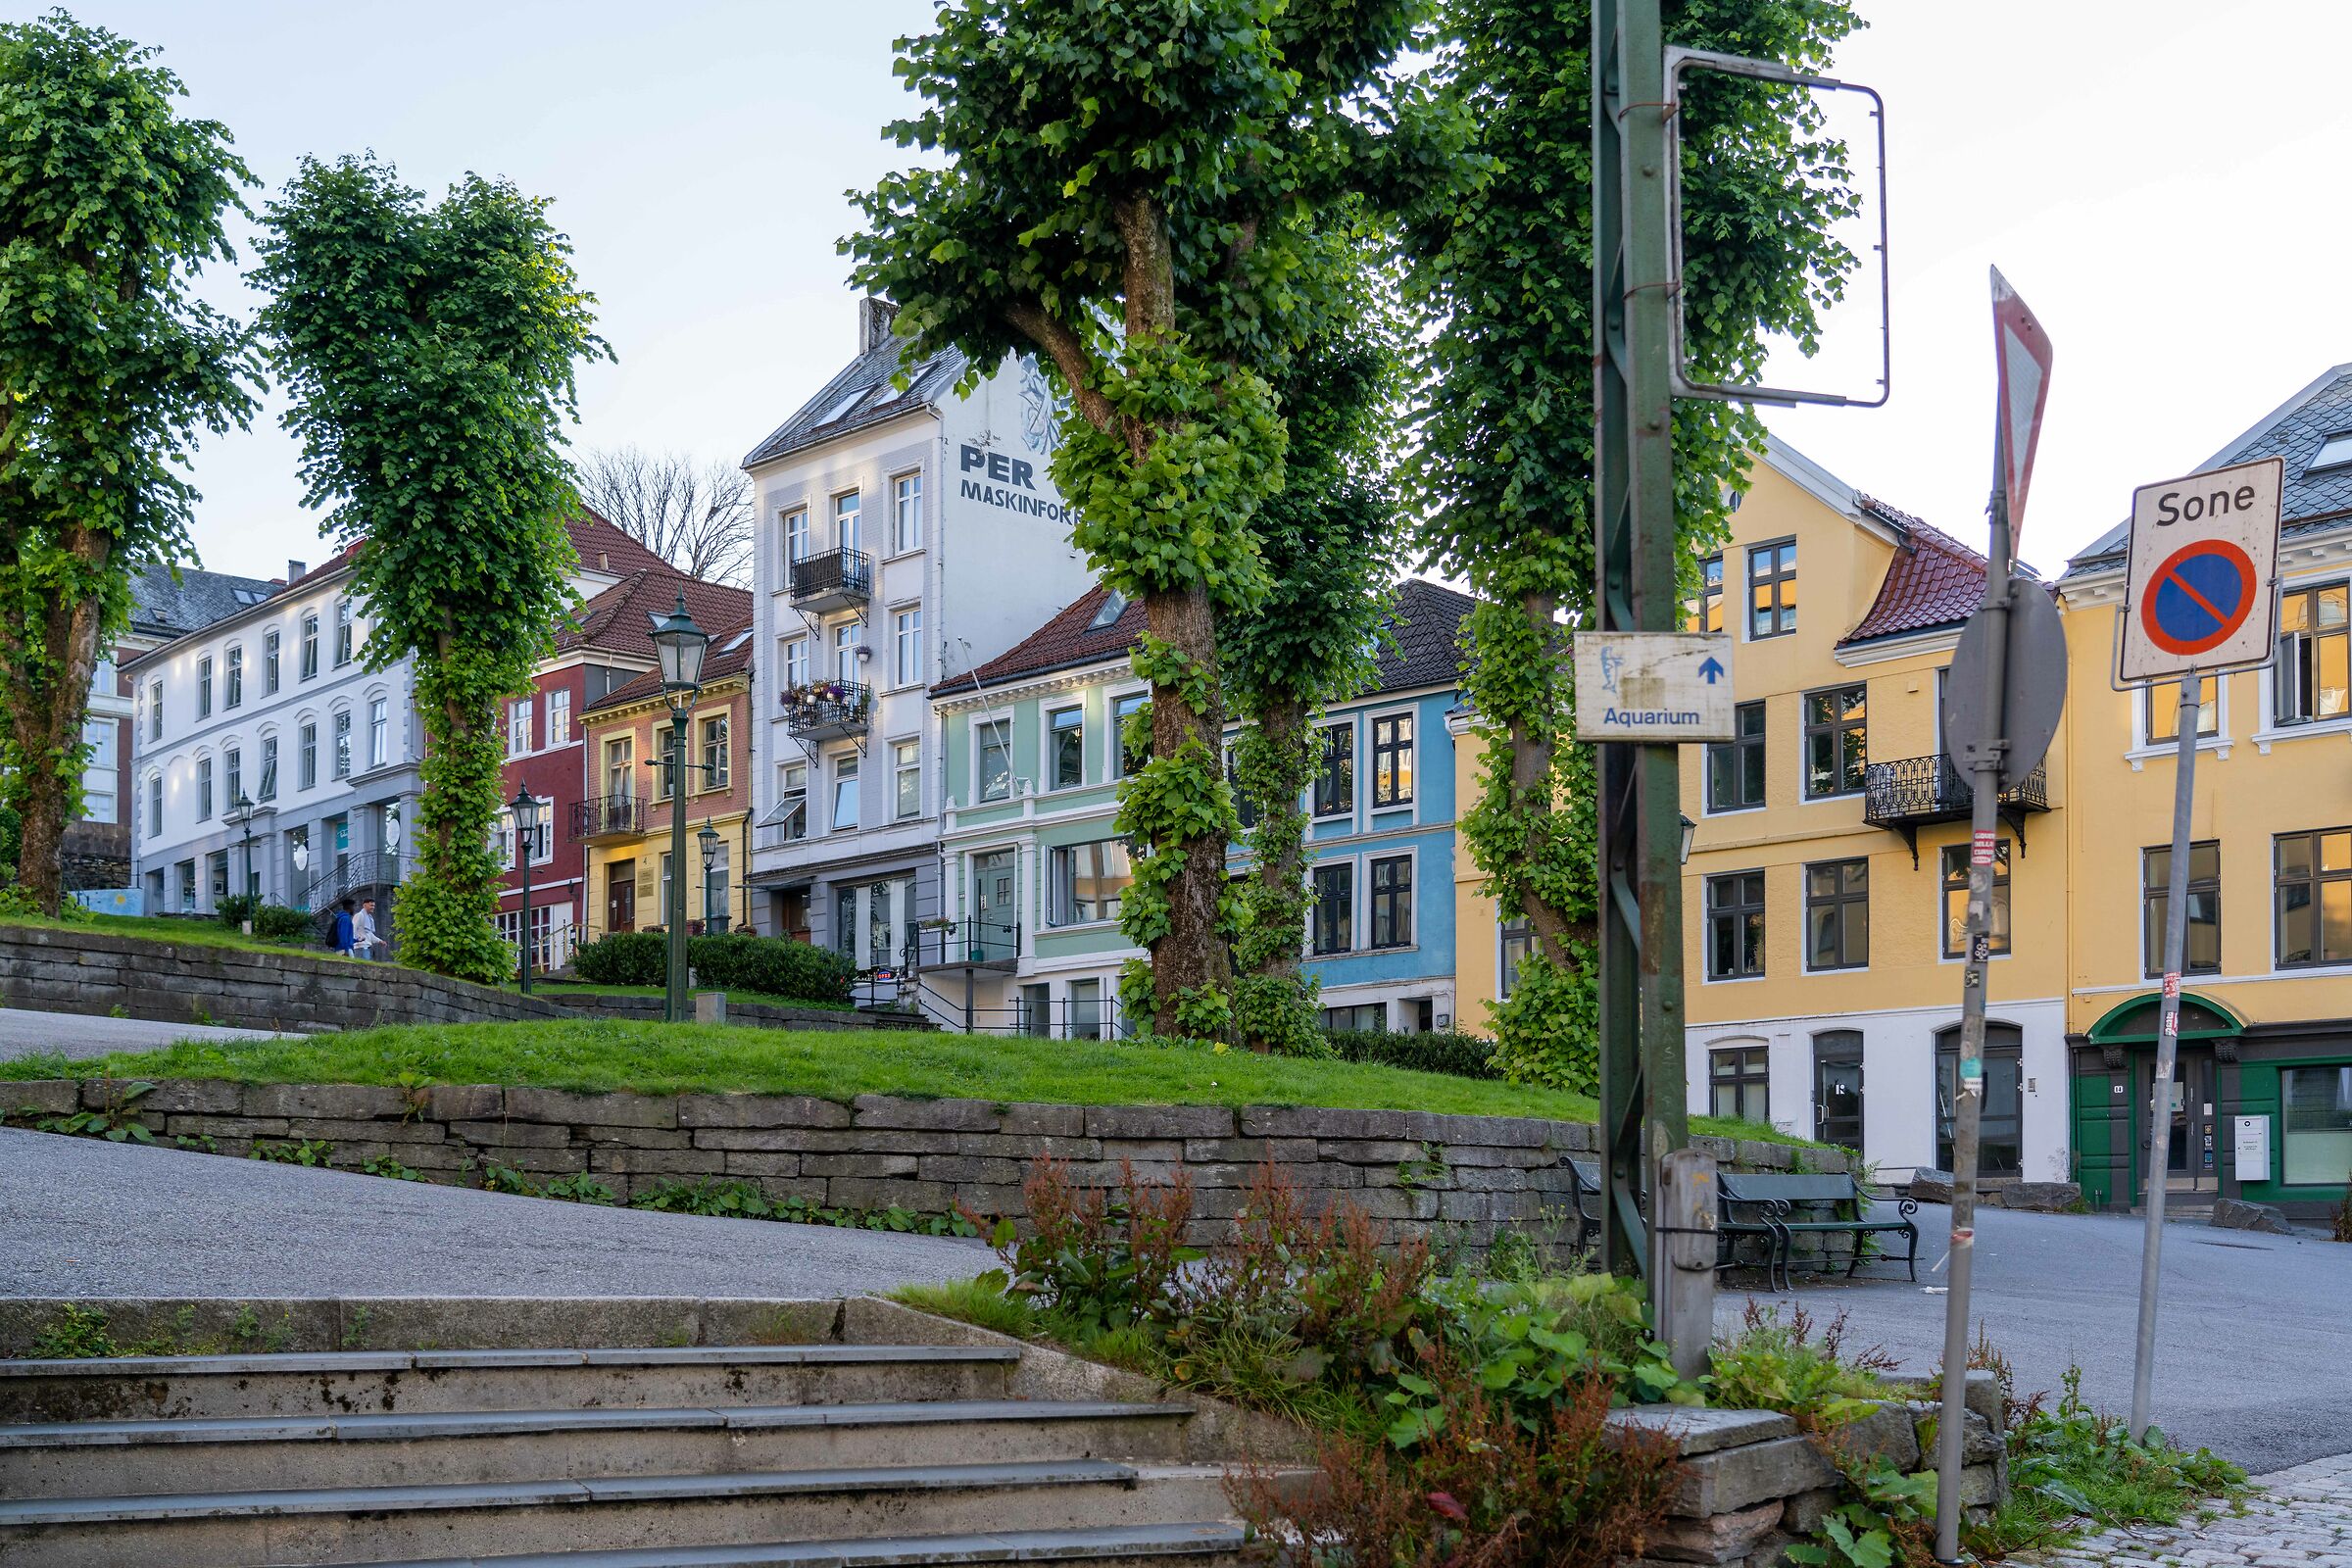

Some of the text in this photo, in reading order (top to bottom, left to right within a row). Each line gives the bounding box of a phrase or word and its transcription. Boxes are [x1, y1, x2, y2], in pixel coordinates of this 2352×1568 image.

[960, 443, 1037, 491] PER
[2156, 485, 2255, 527] Sone
[1603, 708, 1700, 727] Aquarium
